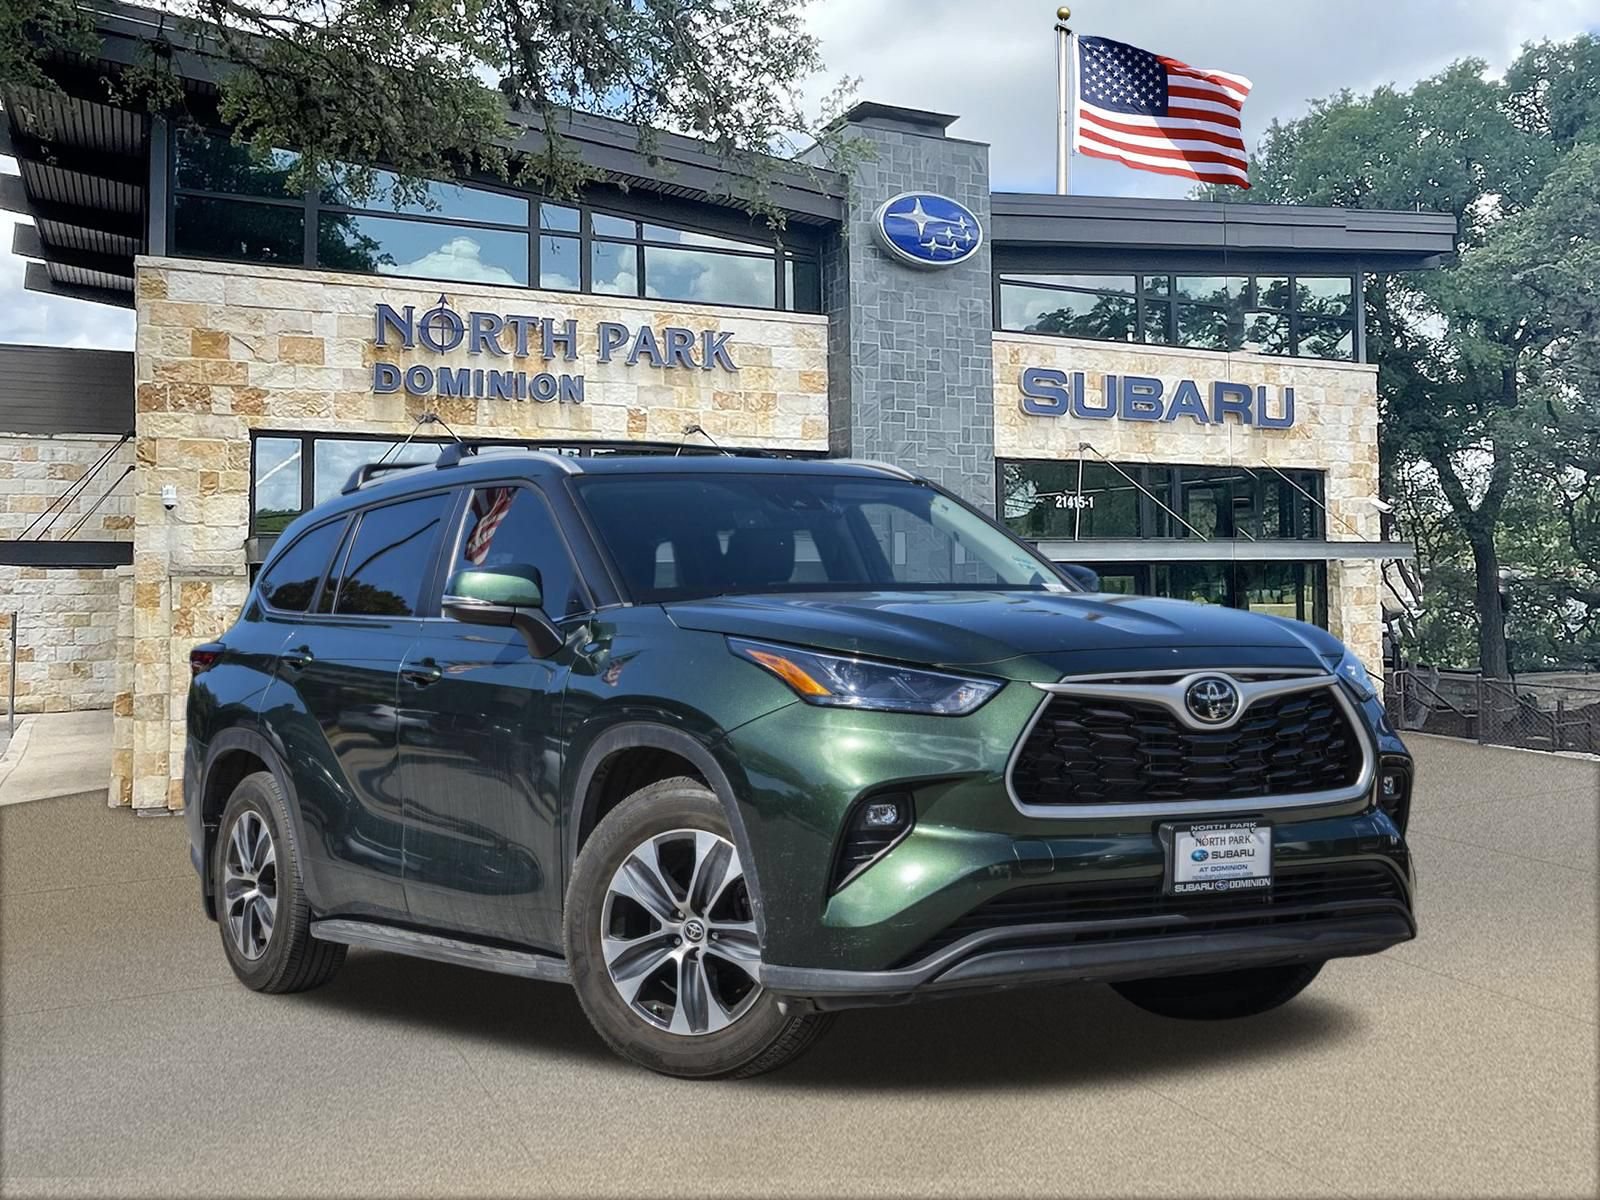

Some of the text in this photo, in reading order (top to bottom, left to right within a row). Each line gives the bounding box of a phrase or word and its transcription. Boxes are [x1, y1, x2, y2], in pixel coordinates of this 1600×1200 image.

[375, 293, 741, 373] NORTH PARK
[373, 362, 585, 404] DOMINION
[1019, 367, 1295, 430] SUBARU
[1055, 495, 1094, 509] 21415-1
[1195, 835, 1251, 847] NORTH PARK
[1211, 849, 1255, 859] SUBARU
[1210, 864, 1248, 872] DOMINION
[1174, 879, 1271, 893] SUBARU DOMINION
